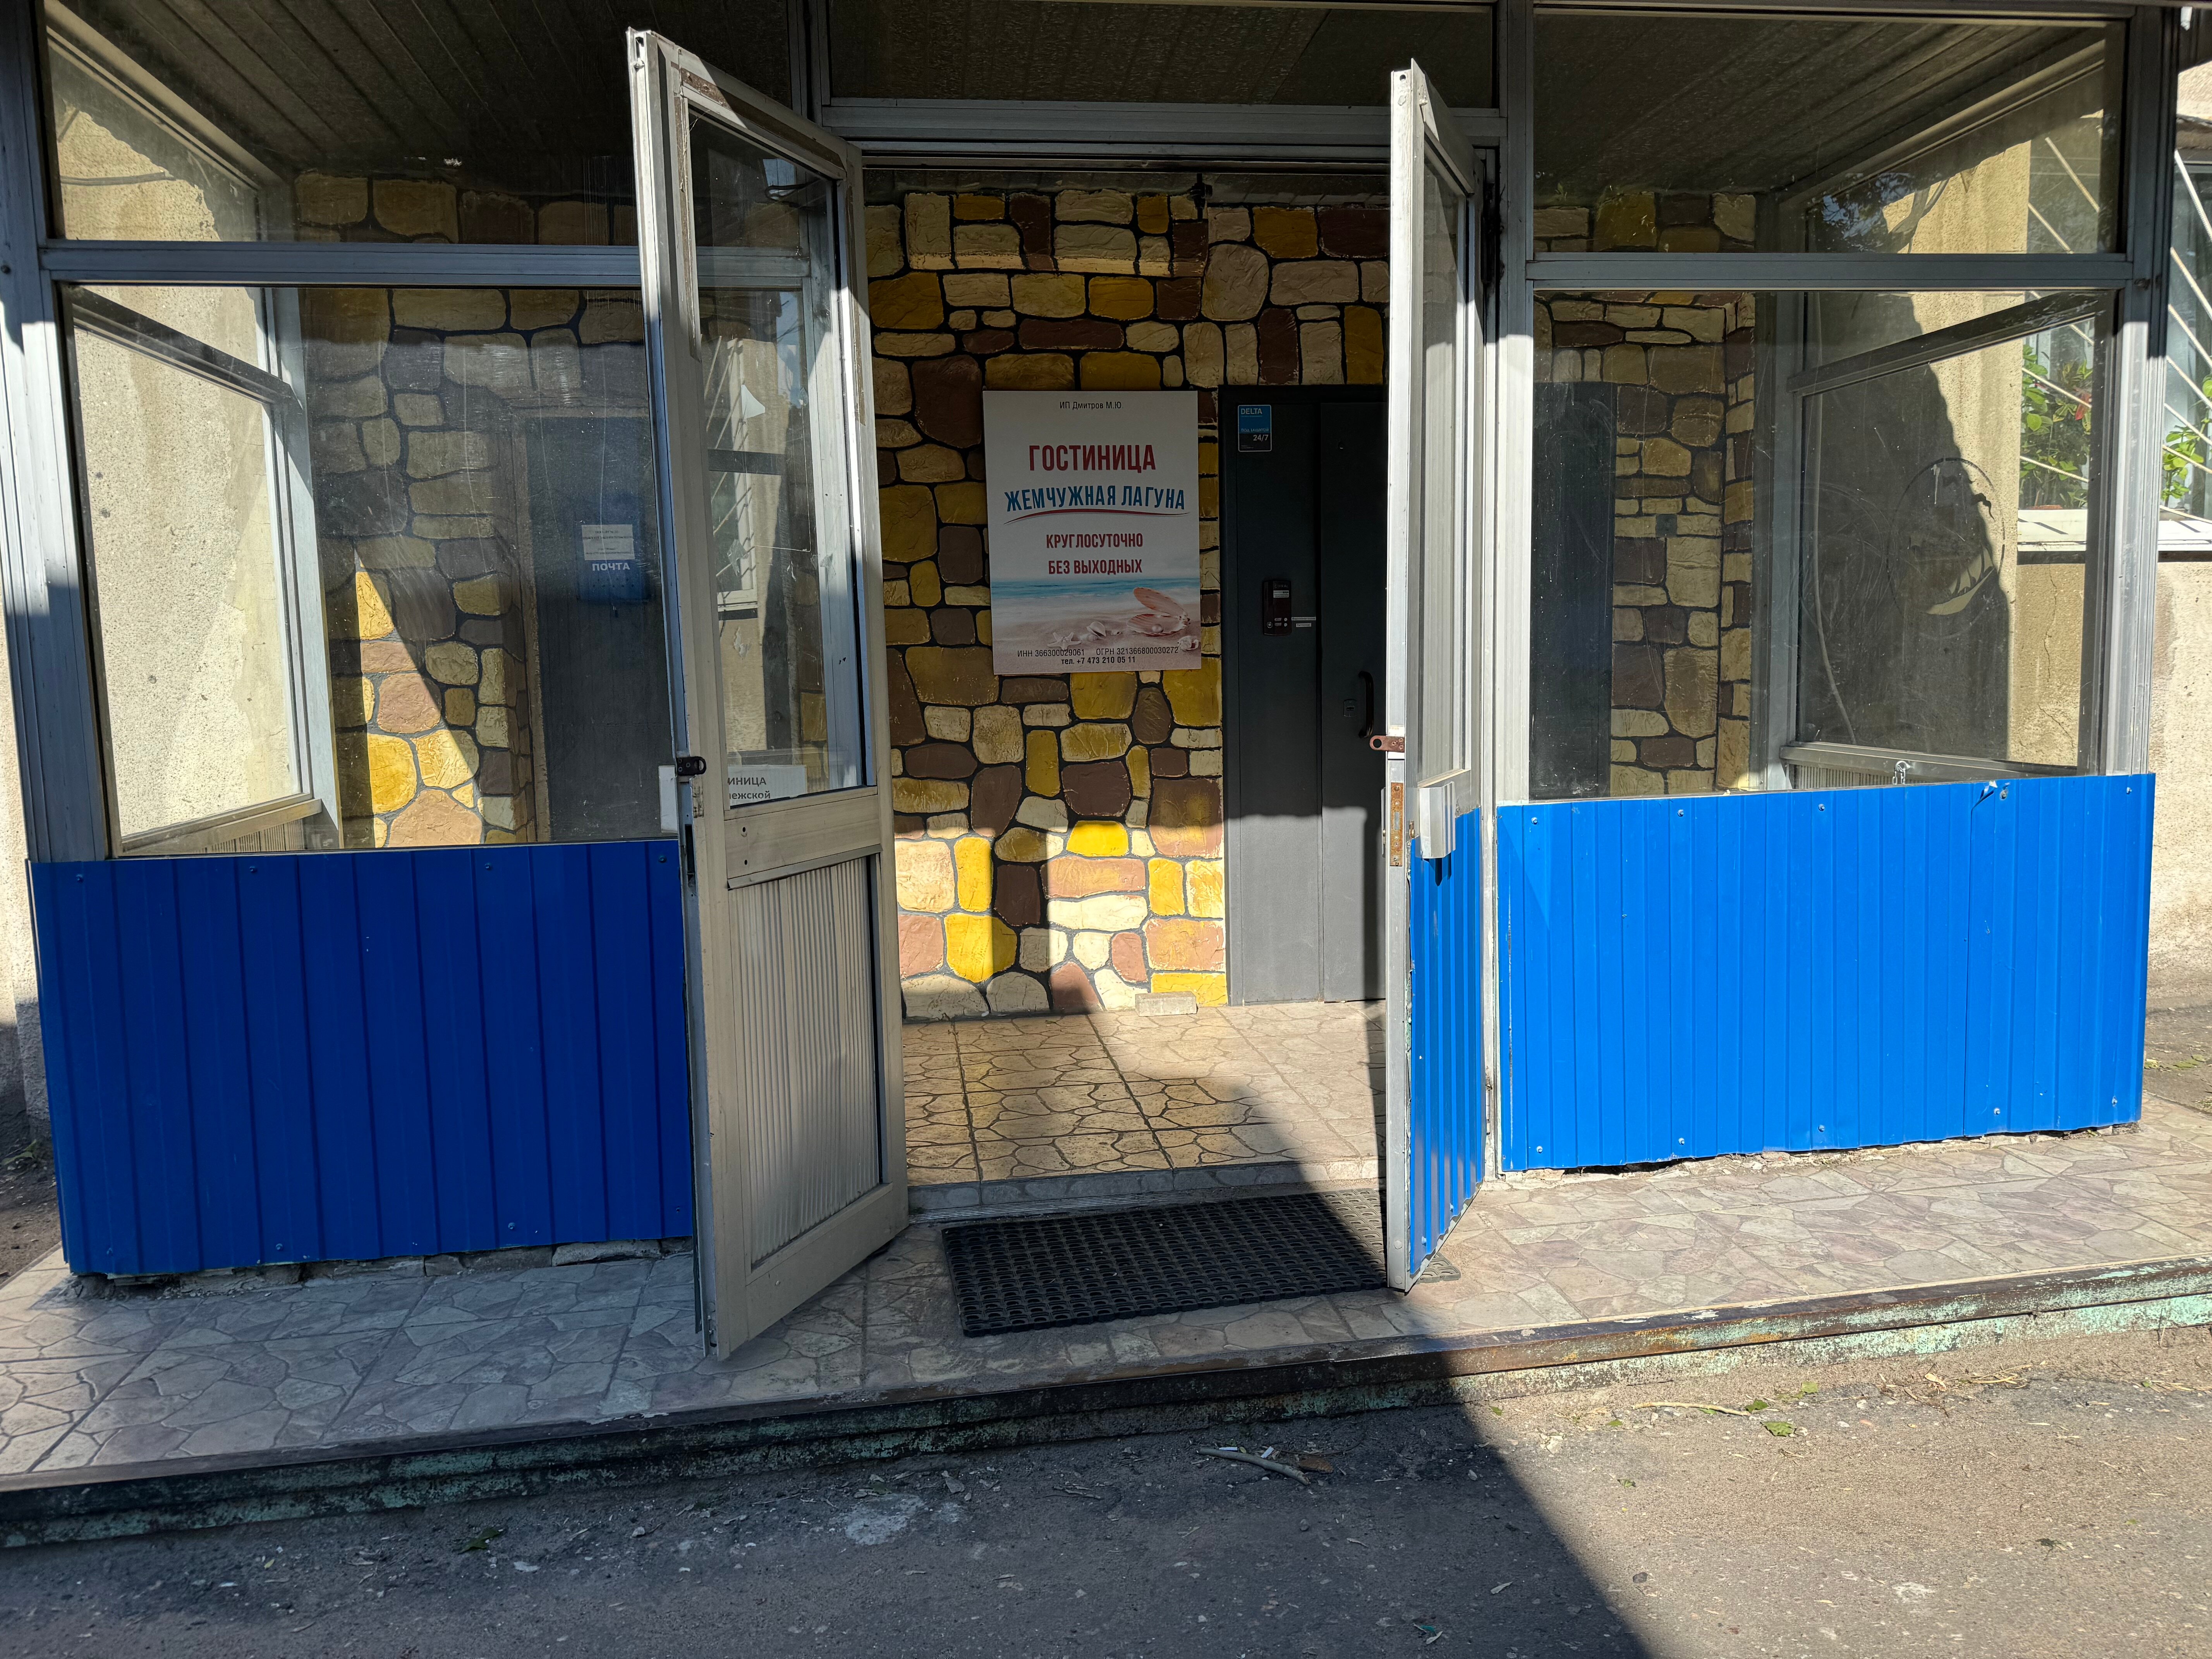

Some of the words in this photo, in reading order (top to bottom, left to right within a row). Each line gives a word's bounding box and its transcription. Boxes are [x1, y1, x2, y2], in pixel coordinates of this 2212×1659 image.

[1060, 401, 1070, 409] ИП
[1072, 401, 1104, 410] Дмитров
[1029, 445, 1156, 473] ГОСТИНИЦА
[1004, 485, 1116, 512] ЖЕМЧУЖНАЯ
[1121, 486, 1185, 510] ЛАГУНА
[1046, 533, 1143, 548] КРУГЛОСУТОЧНО
[592, 563, 630, 571] ПОЧТА
[1048, 560, 1070, 574] БЕЗ
[1074, 559, 1142, 575] ВЫХОДНЫХ
[1035, 649, 1085, 657] 366300029061
[1117, 646, 1179, 654] 321366800030272
